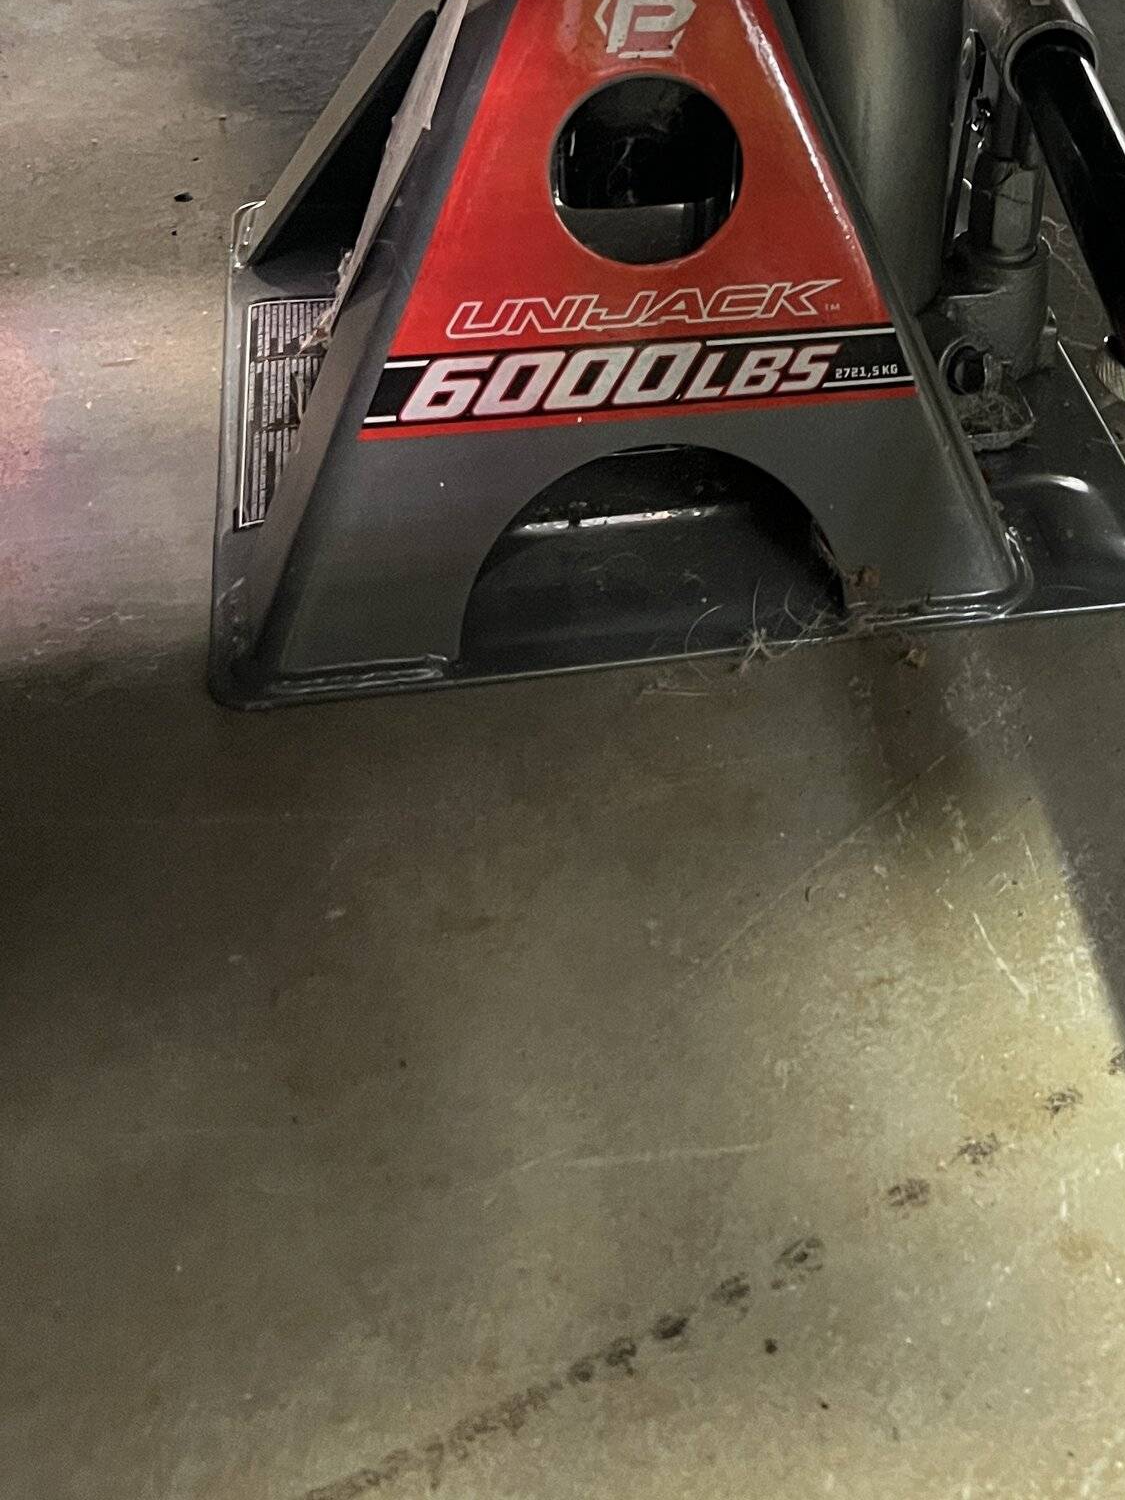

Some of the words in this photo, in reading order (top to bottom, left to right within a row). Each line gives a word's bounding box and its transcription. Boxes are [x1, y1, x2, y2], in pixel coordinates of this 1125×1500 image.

[446, 278, 842, 339] UNIJACK
[835, 365, 879, 380] 2721,5
[882, 363, 898, 375] KG
